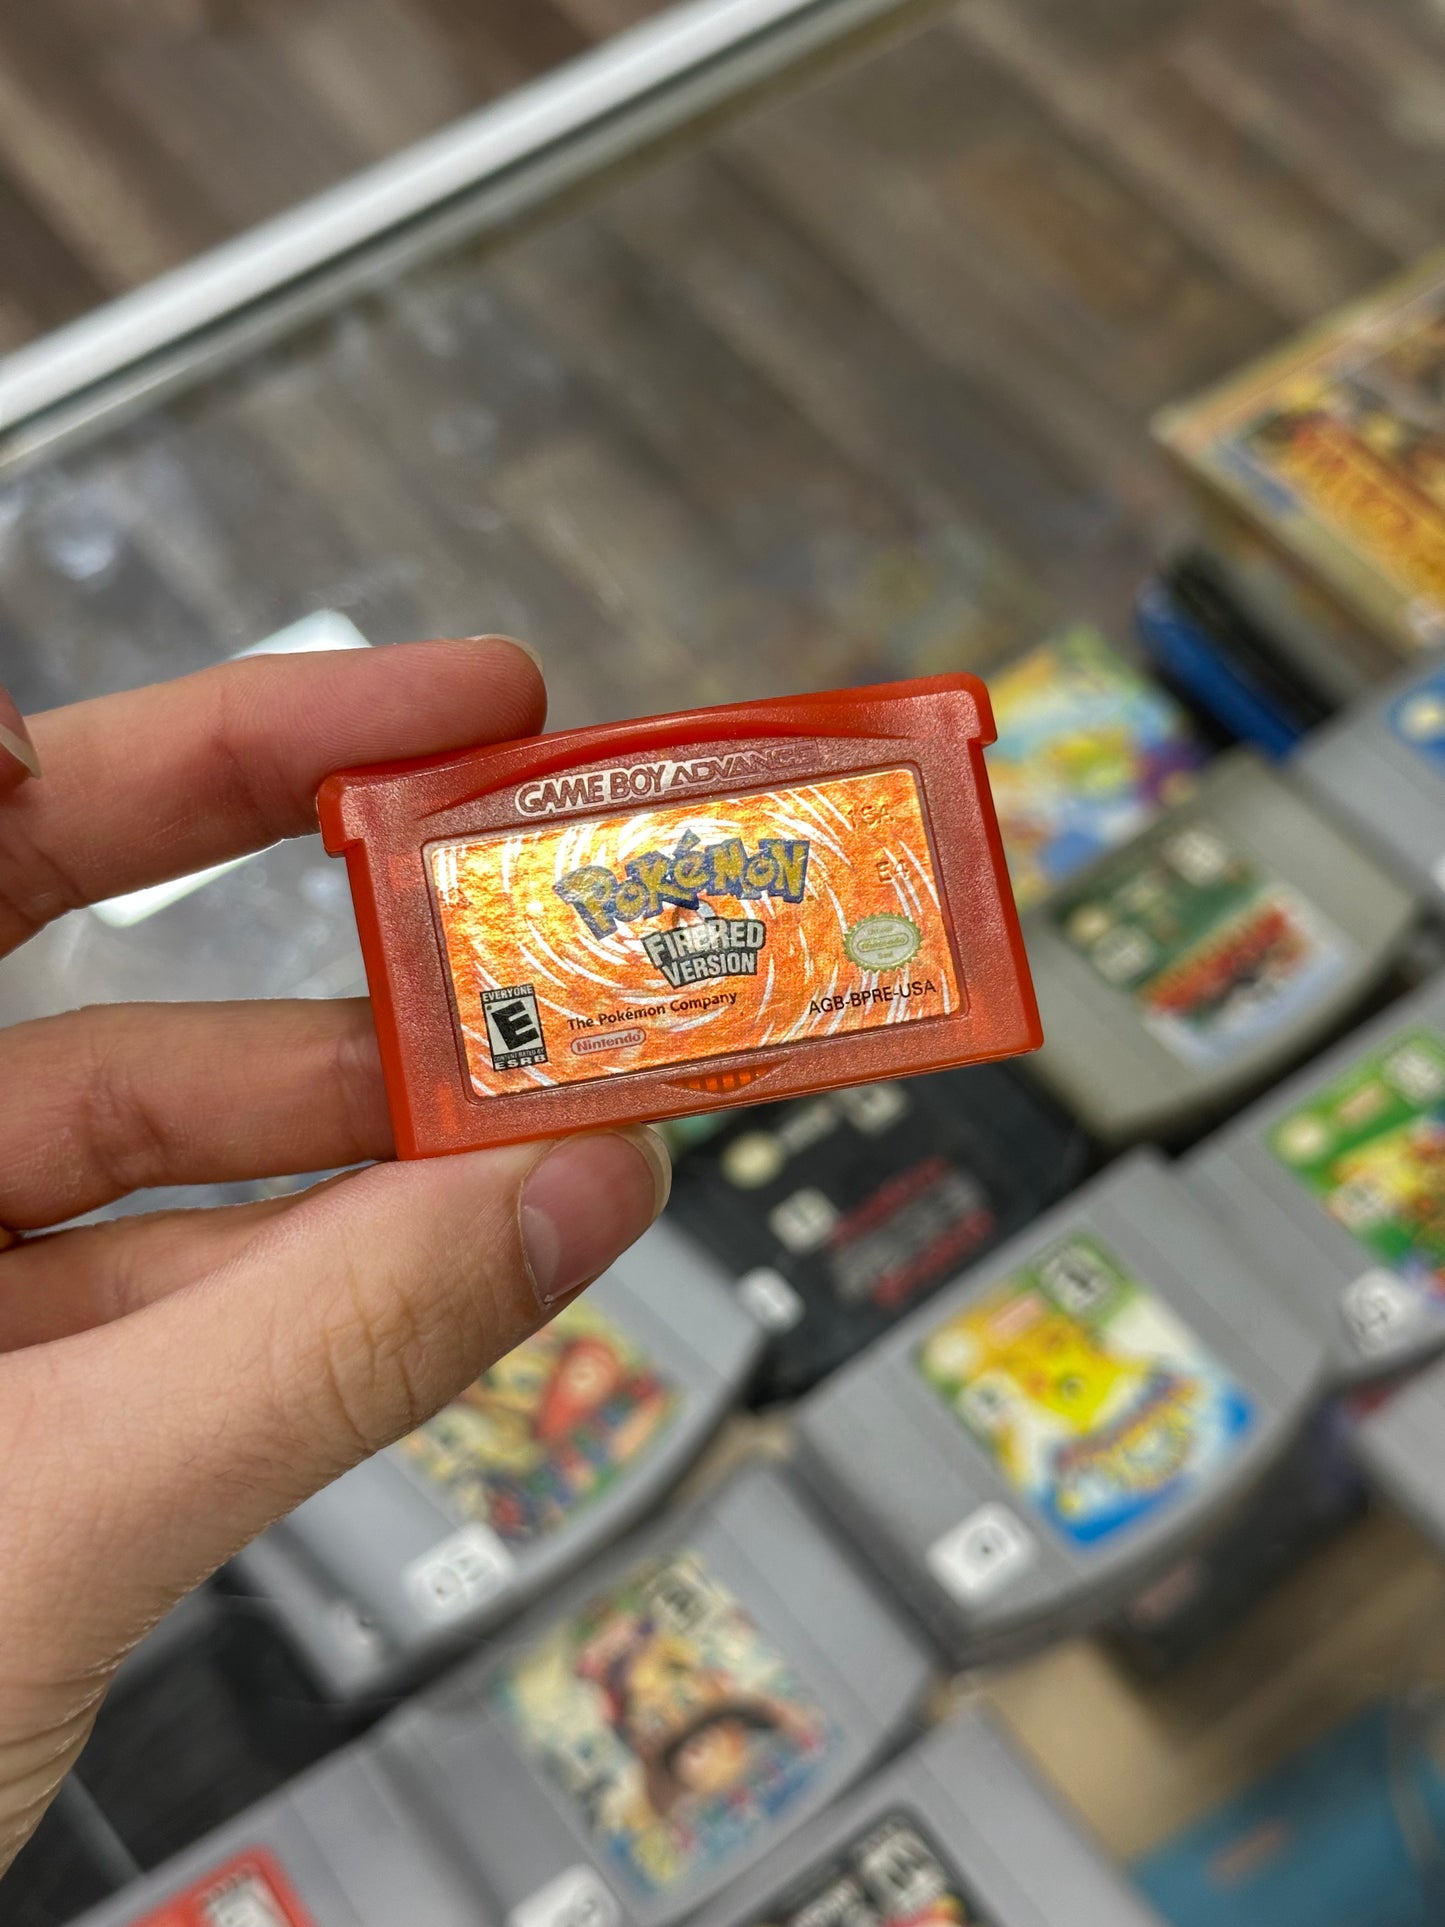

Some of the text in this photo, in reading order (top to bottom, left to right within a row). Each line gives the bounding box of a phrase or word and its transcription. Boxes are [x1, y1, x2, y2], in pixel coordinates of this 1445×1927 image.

[517, 747, 811, 814] GAME BOY ADVANCE
[661, 952, 757, 988] VERSION
[482, 985, 533, 1002] EVERYONE
[567, 992, 738, 1031] The Pokémon Company
[809, 980, 937, 1016] AGB-BPRE-USA
[491, 1000, 540, 1051] E
[576, 1030, 642, 1054] Nintendo
[495, 1055, 547, 1070] ESRB
